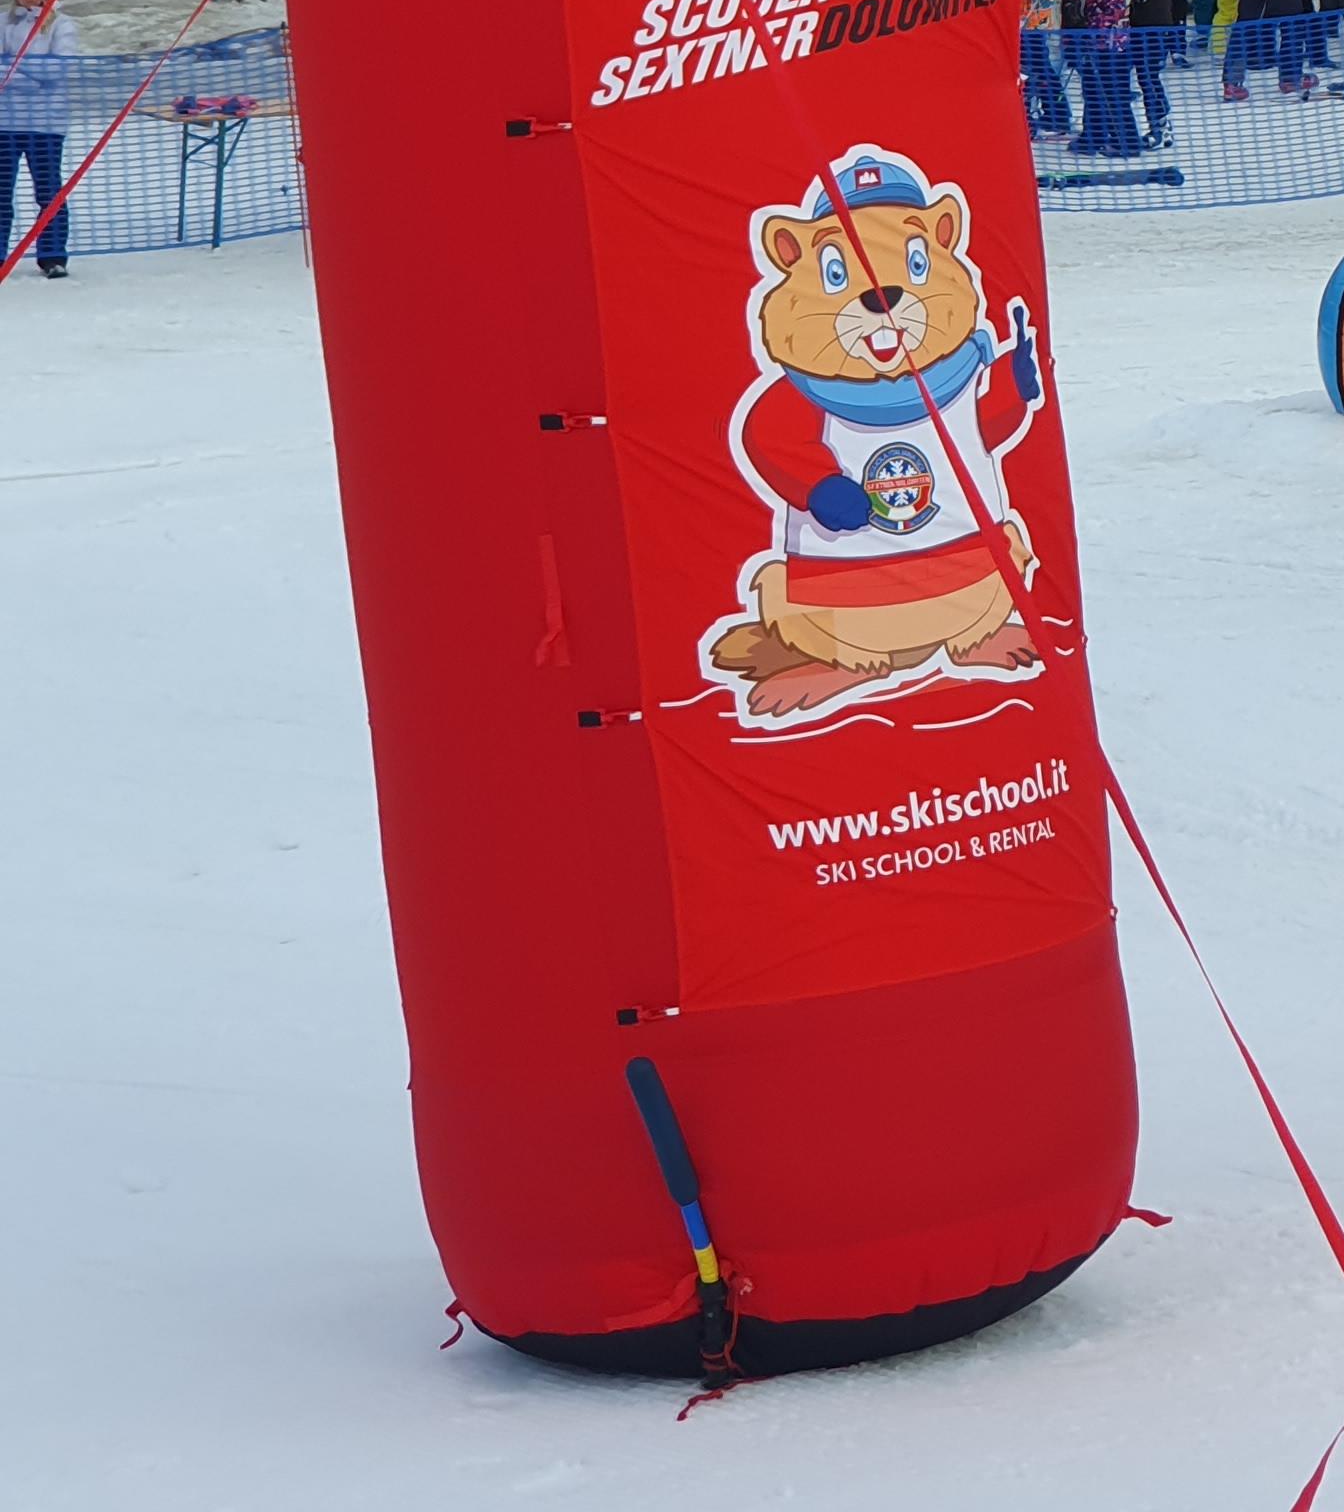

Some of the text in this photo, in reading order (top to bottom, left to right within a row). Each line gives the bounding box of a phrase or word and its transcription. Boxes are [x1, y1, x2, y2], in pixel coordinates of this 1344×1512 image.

[767, 758, 1070, 850] www.skischool.it
[815, 817, 1056, 886] SKI SCHOOL & RENTAL
